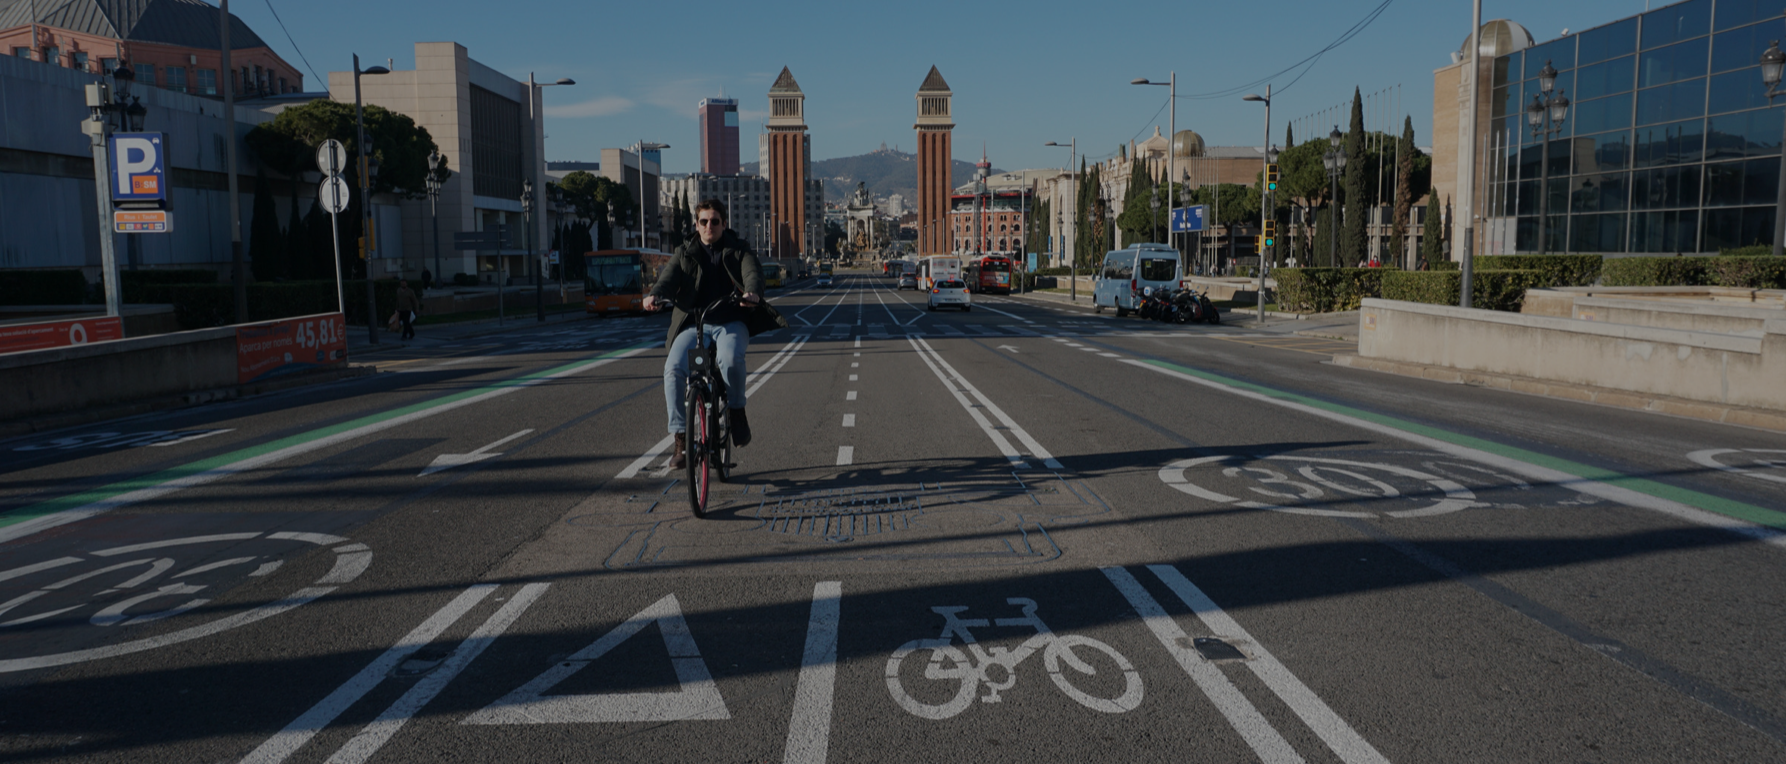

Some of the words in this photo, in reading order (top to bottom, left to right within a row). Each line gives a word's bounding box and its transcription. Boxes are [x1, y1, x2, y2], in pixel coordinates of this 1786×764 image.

[115, 137, 157, 195] P
[239, 341, 261, 355] Aparca
[262, 341, 272, 352] per
[1221, 464, 1401, 500] 30
